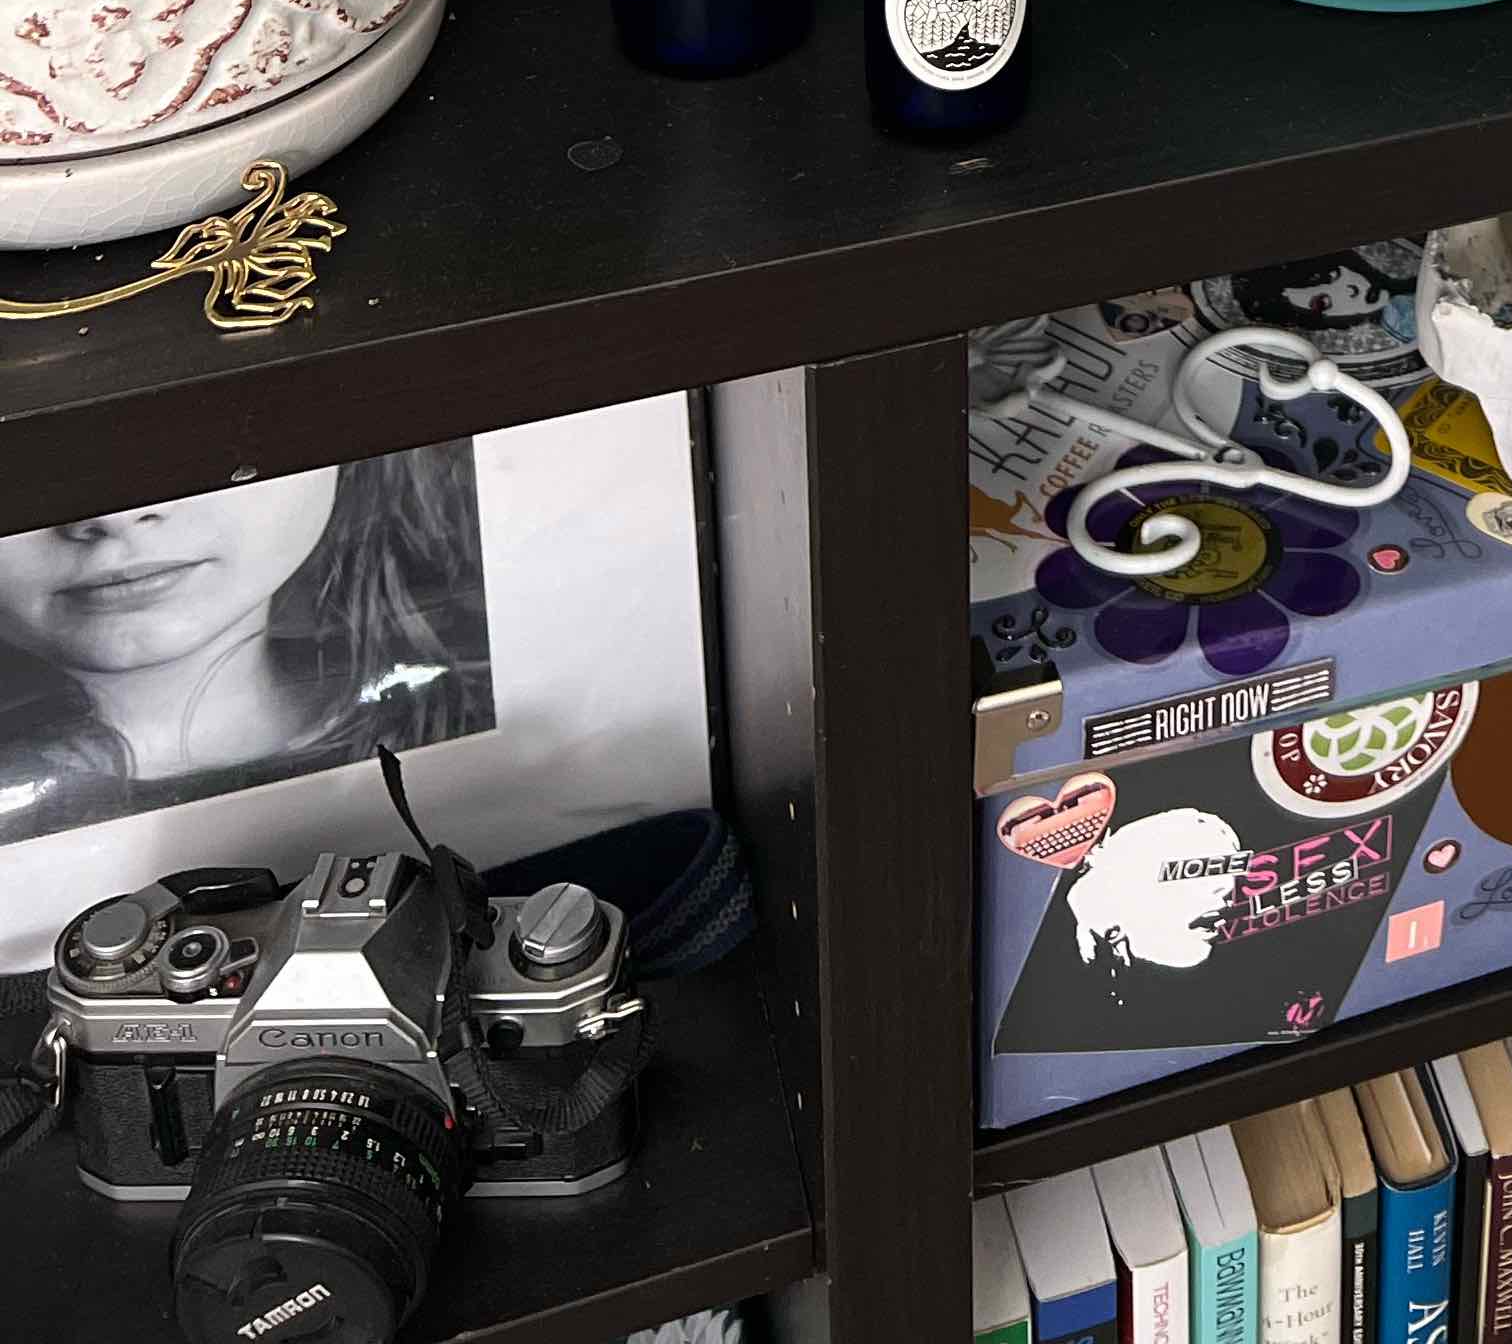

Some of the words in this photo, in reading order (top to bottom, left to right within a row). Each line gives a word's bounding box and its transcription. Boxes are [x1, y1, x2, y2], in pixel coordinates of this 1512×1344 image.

[1039, 436, 1101, 498] COFFEE
[1155, 696, 1217, 742] RIGHT
[1369, 688, 1460, 793] SAVORY
[1158, 855, 1247, 883] MORE
[1254, 860, 1353, 914] LESS
[1217, 873, 1387, 941] VIOLENCE
[112, 1023, 198, 1043] AE-1
[258, 1028, 385, 1048] Canon
[1407, 1229, 1426, 1275] HALL
[1432, 1210, 1449, 1267] KEVIN
[236, 1283, 332, 1340] TAMRON
